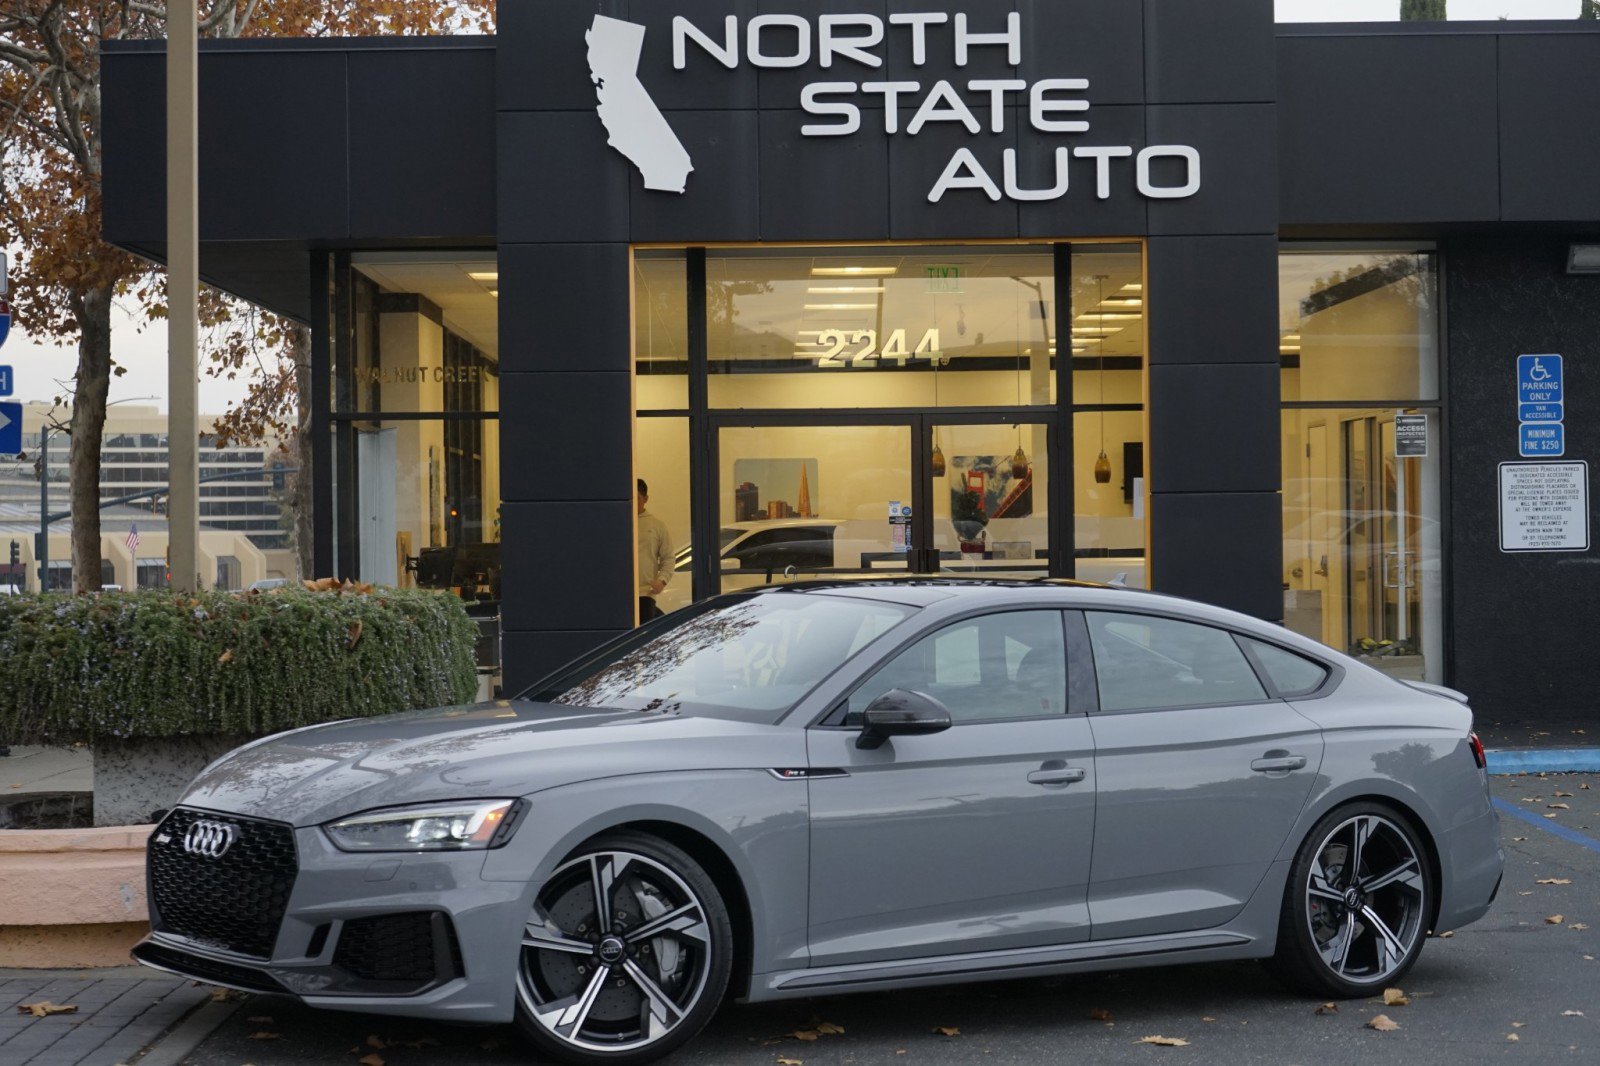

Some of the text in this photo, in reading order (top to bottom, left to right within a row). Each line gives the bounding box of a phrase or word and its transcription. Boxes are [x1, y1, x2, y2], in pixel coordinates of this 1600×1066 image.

[672, 11, 1022, 70] NORTH
[800, 78, 1090, 136] STATE
[926, 144, 1202, 203] AUTO
[816, 328, 942, 368] 2244
[354, 366, 488, 383] WALNUT CREEK
[1522, 382, 1559, 391] PARKING
[1529, 392, 1551, 401] ONLY
[1527, 429, 1556, 438] MINIMUM
[1524, 440, 1559, 450] FINE $250
